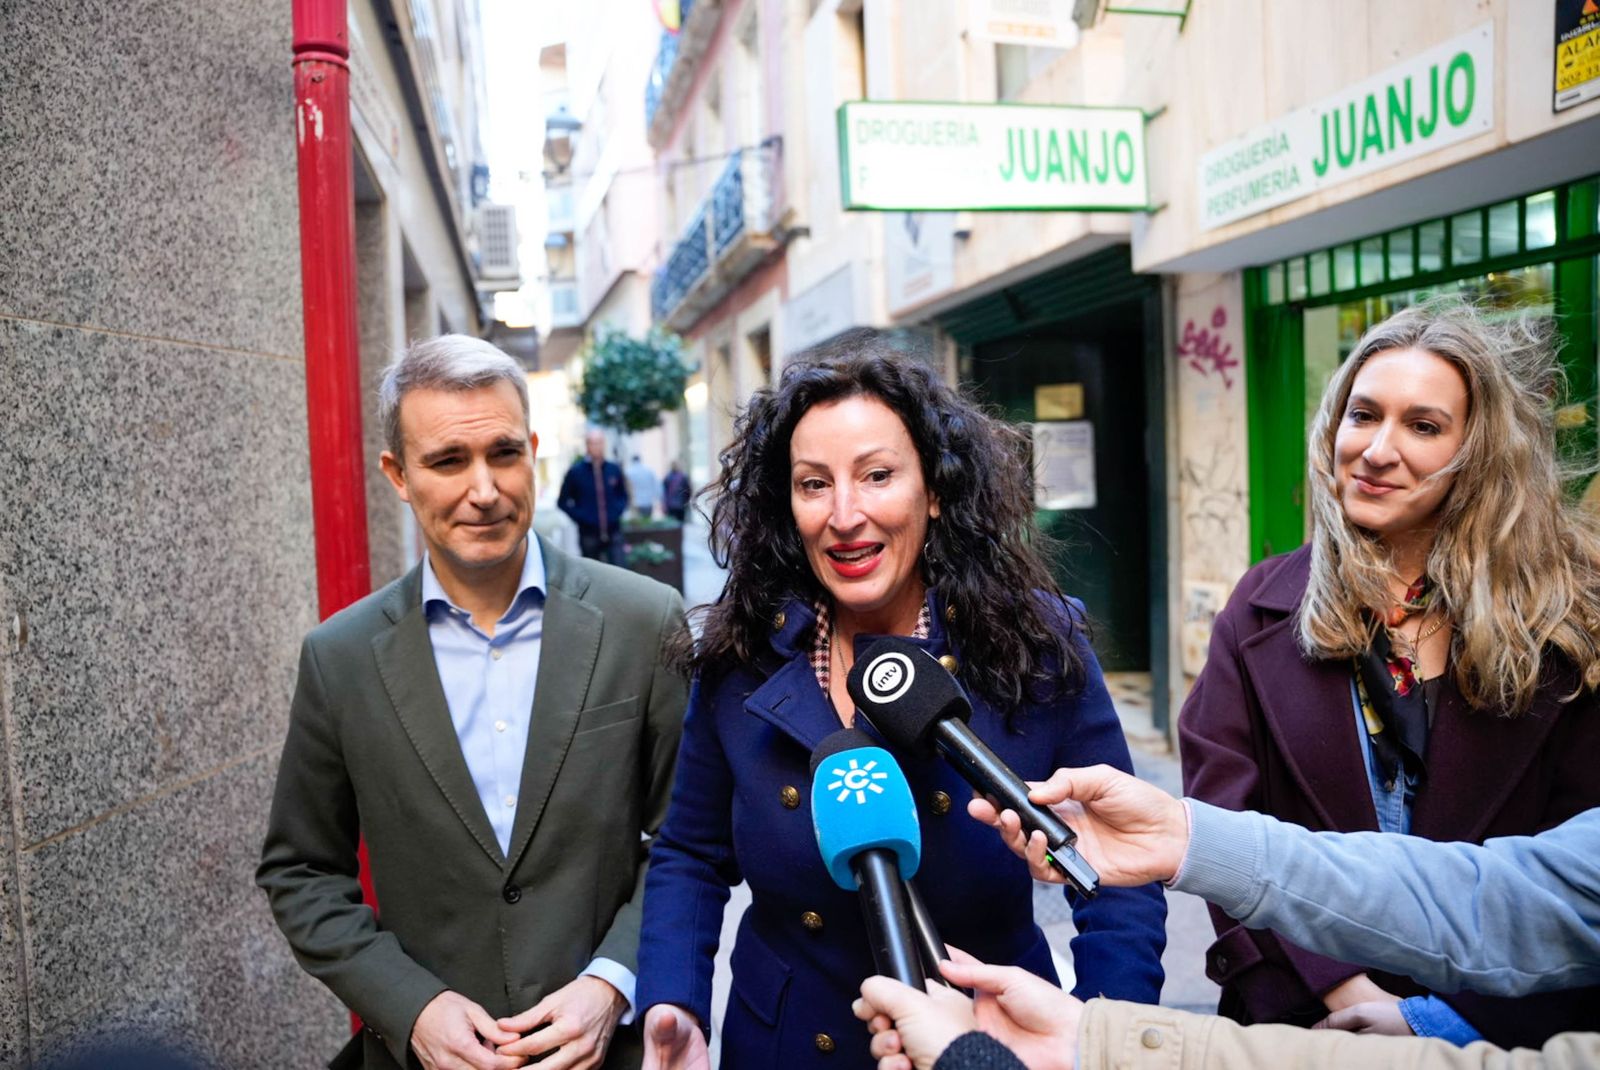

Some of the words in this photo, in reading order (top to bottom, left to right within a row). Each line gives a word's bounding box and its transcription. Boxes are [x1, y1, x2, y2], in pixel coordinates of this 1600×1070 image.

[1313, 51, 1476, 178] JUANJO
[999, 127, 1135, 184] JUANJO
[877, 666, 898, 688] intv
